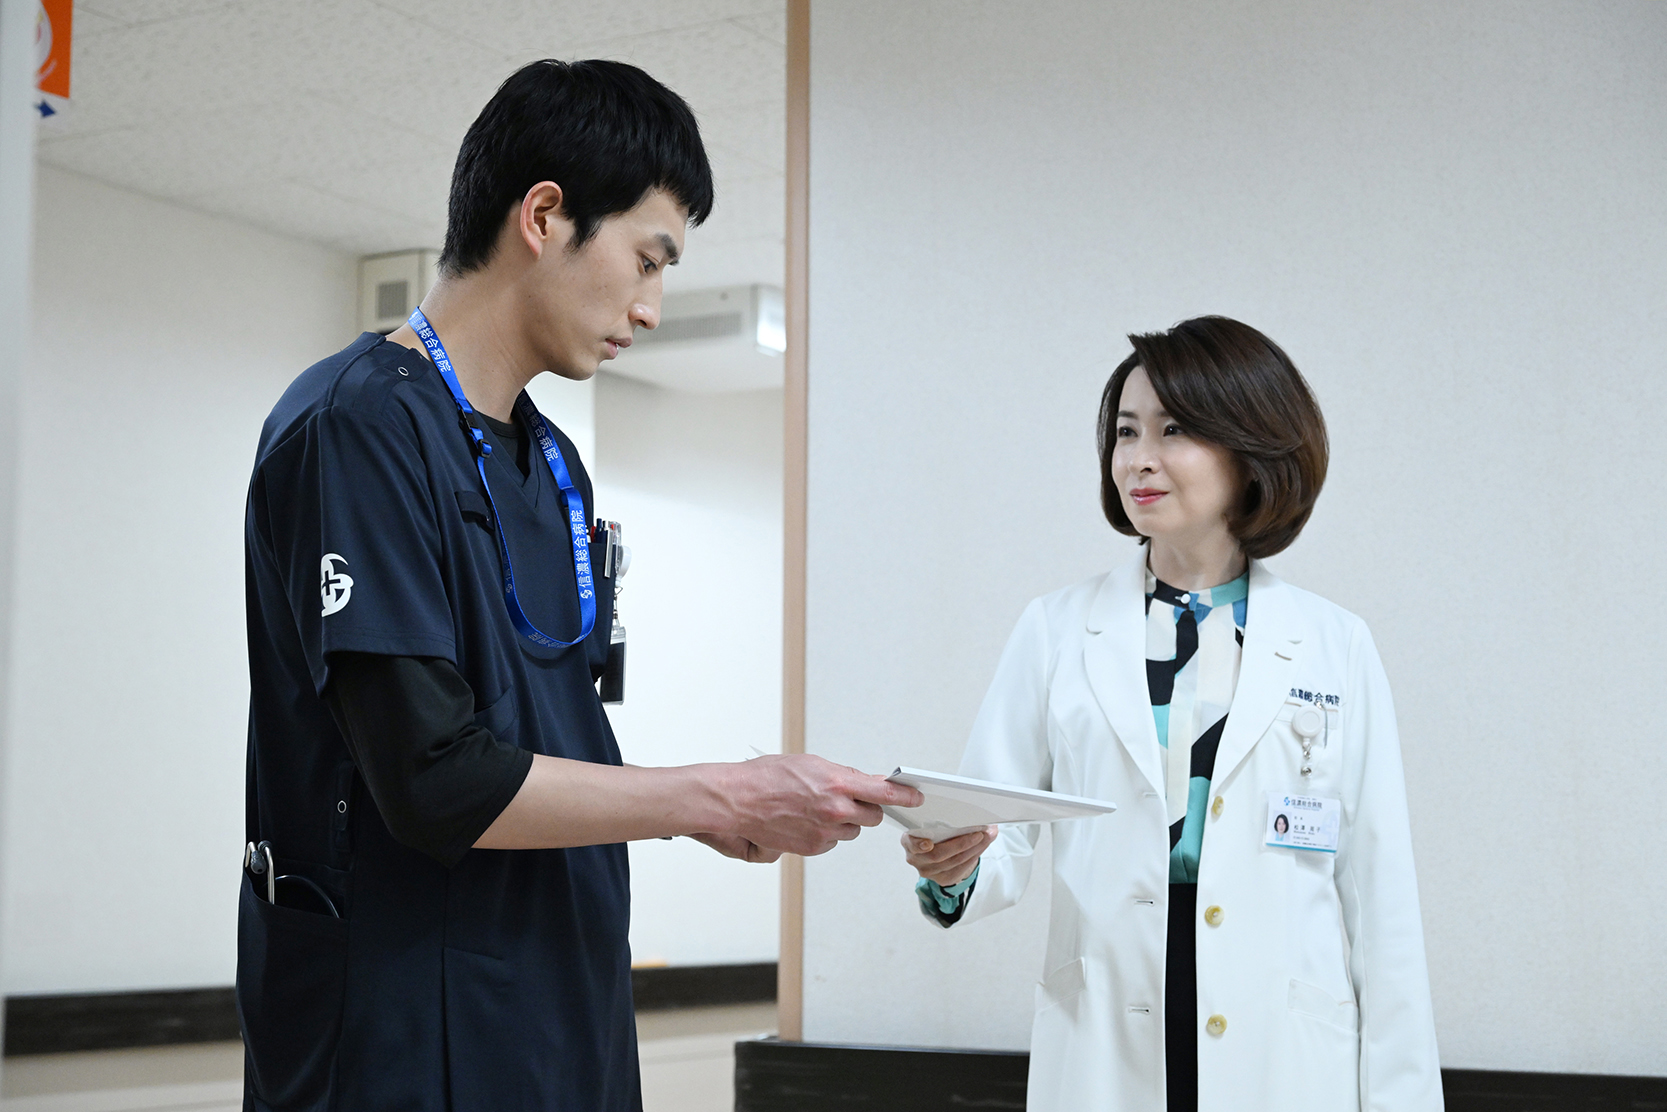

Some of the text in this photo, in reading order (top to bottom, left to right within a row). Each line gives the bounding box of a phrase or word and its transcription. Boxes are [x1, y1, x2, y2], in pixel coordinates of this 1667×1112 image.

[571, 510, 592, 588] 信濃総合病院
